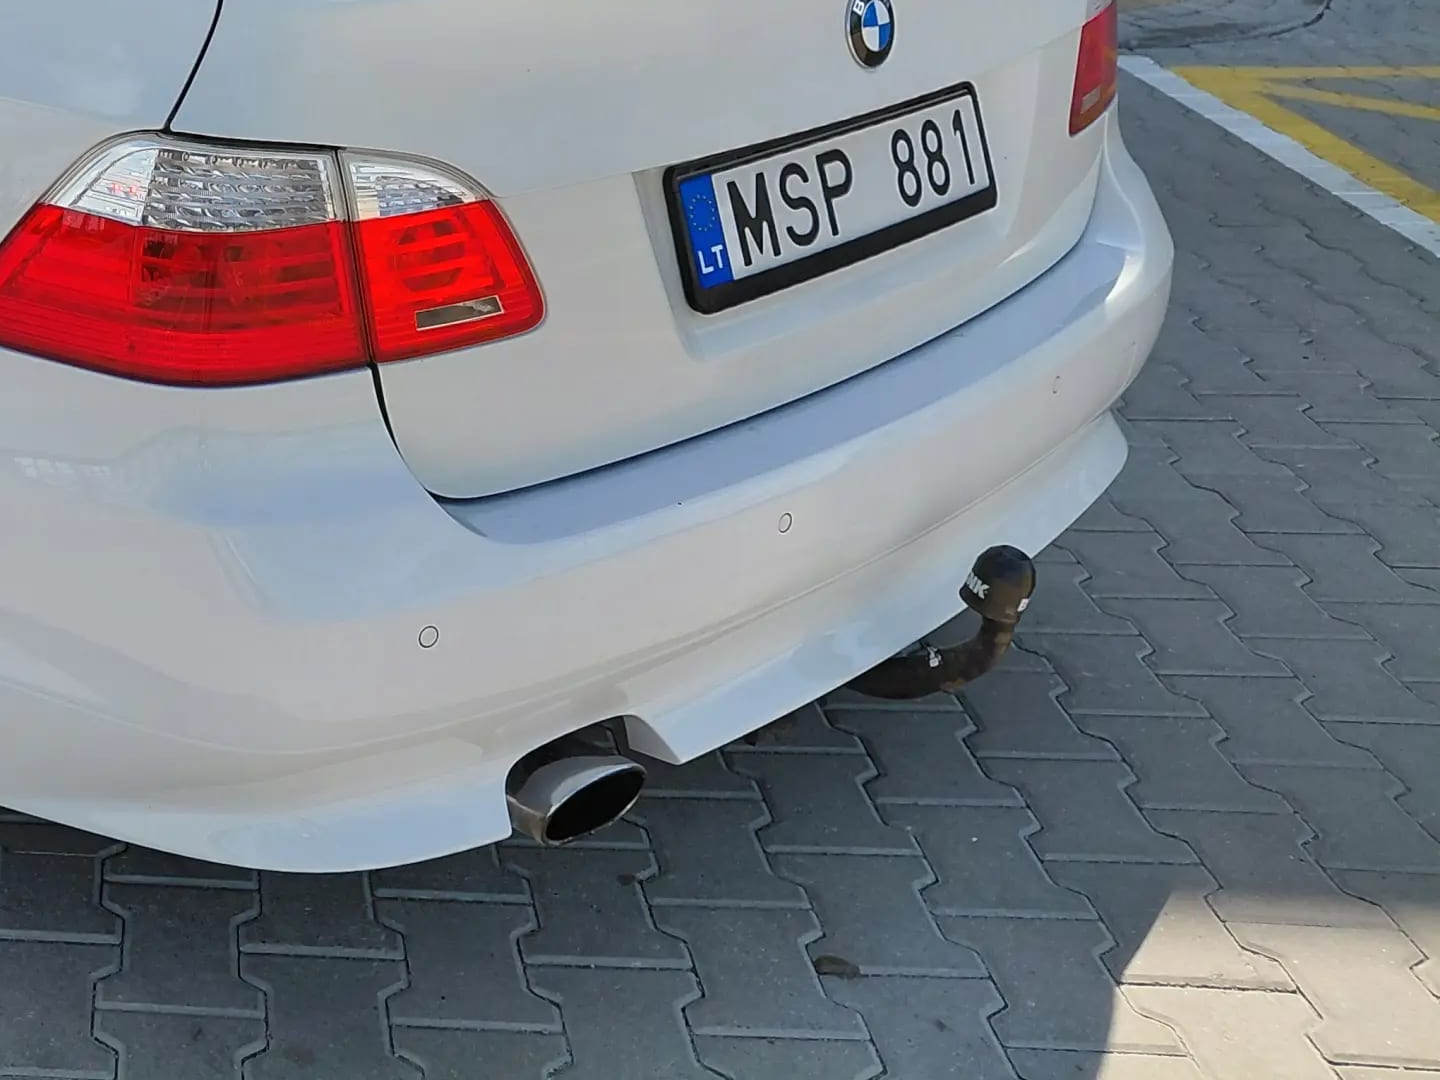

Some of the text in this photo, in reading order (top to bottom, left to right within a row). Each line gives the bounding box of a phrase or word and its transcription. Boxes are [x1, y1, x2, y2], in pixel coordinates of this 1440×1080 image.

[726, 108, 975, 267] MSP 881
[698, 244, 725, 275] LT
